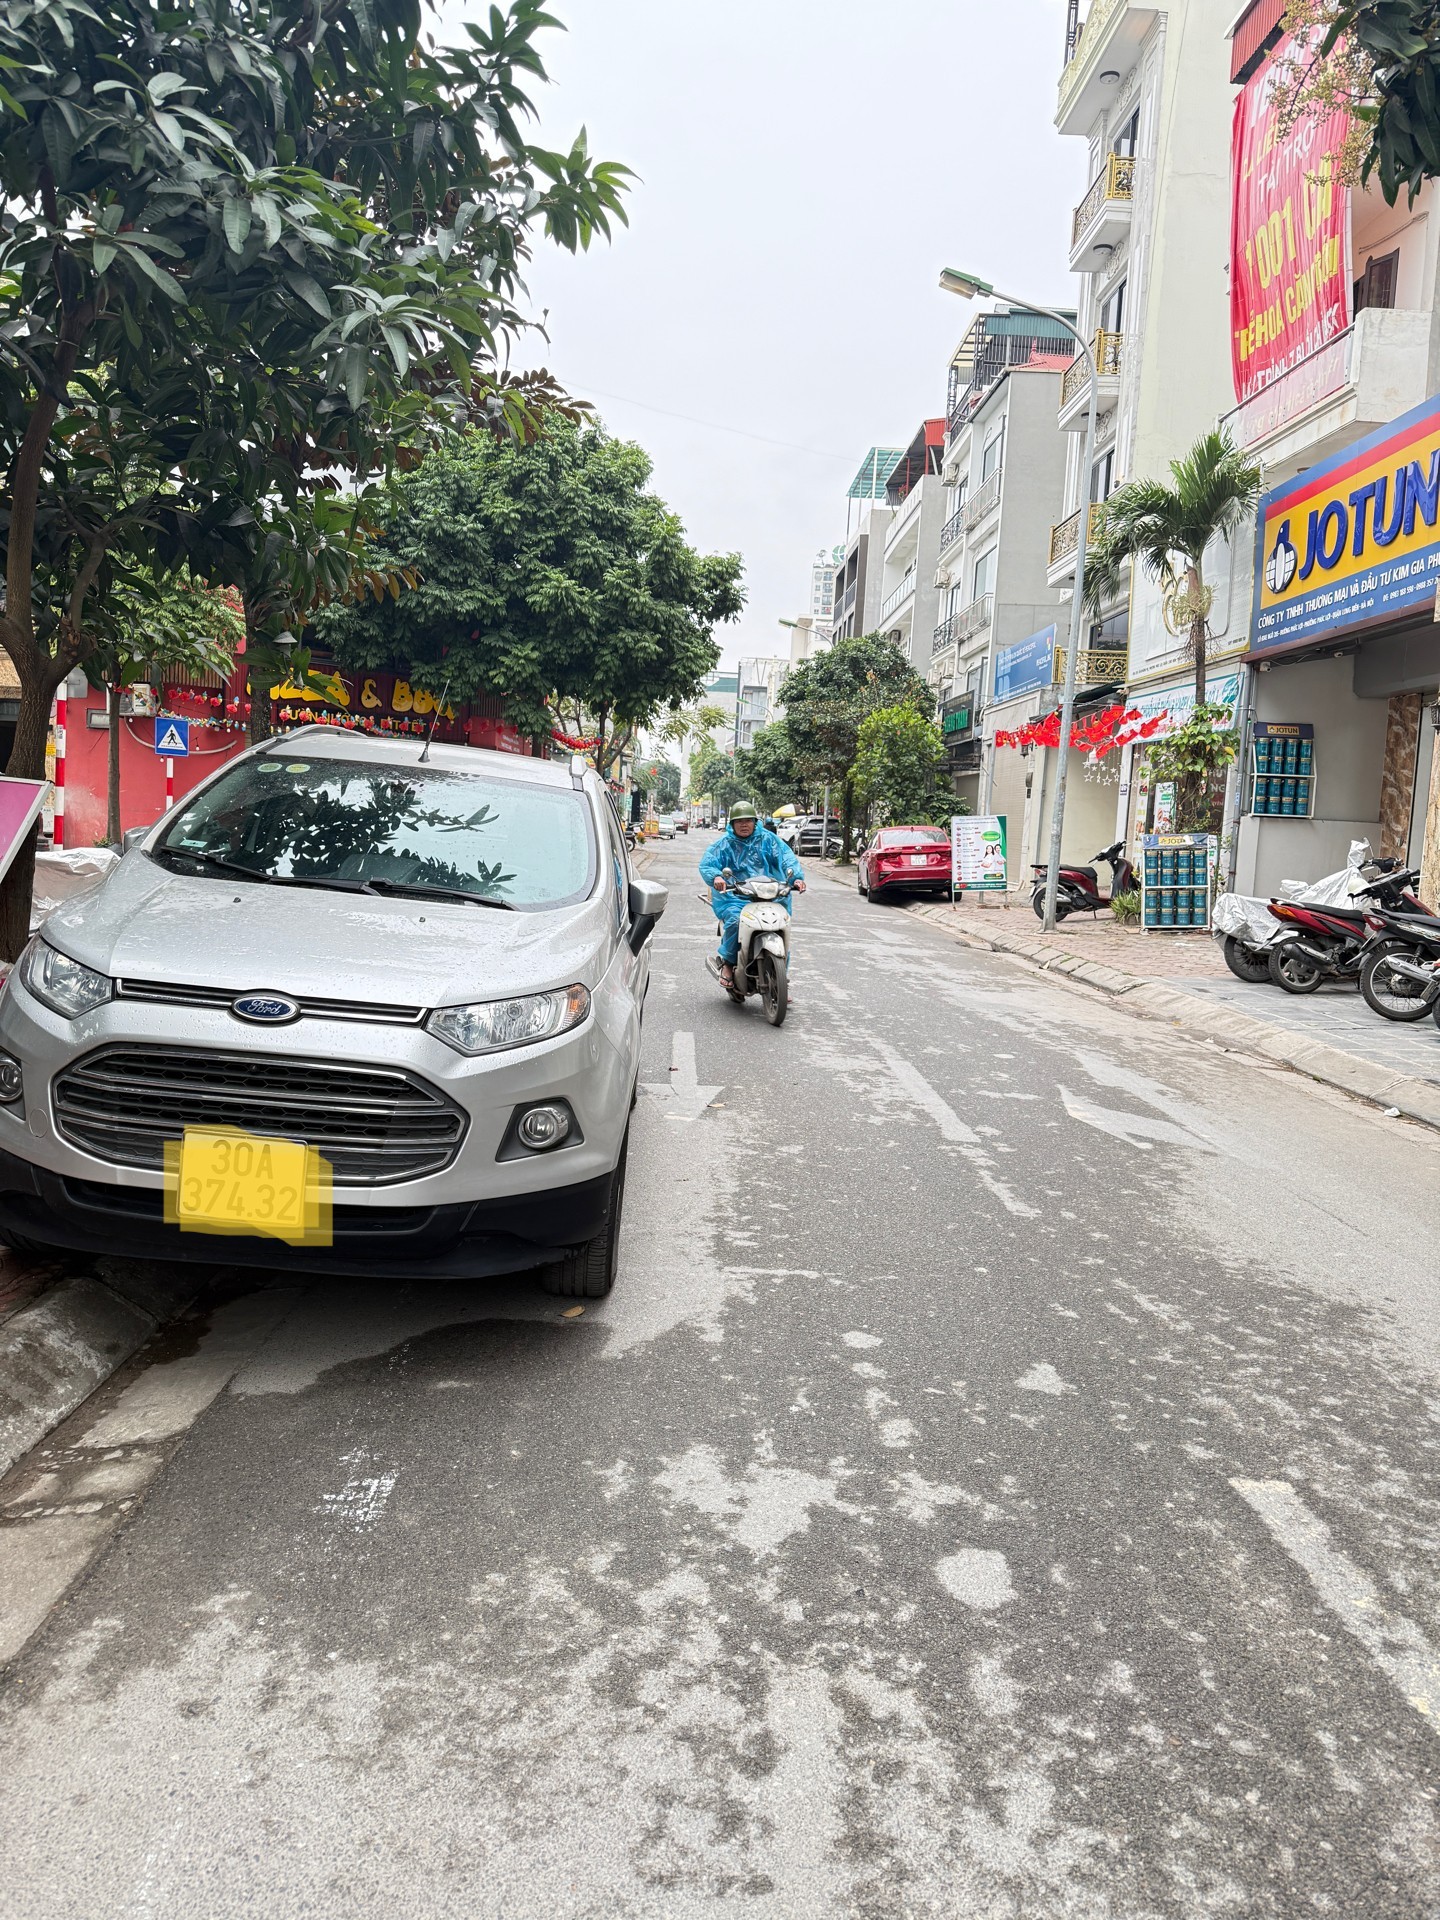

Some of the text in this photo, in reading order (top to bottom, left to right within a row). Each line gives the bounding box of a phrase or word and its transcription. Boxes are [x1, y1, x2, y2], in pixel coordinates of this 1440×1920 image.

[1283, 117, 1317, 175] TRỢ
[1245, 195, 1296, 299] 1001
[1298, 448, 1440, 580] JOTUN
[1257, 613, 1275, 629] CÔNG
[1276, 610, 1285, 623] TY
[1286, 603, 1304, 620] TNHH
[1305, 592, 1334, 613] THƯƠNG
[1334, 586, 1349, 604] MẠI
[1350, 578, 1360, 597] VÀ
[1361, 571, 1378, 594] ĐẦU
[1380, 568, 1393, 587] TƯ
[1392, 563, 1410, 583] KIM
[1410, 558, 1425, 576] GIA
[360, 678, 383, 709] &
[247, 999, 283, 1015] Ford
[211, 1139, 273, 1180] 30A
[182, 1176, 298, 1222] 374.32
